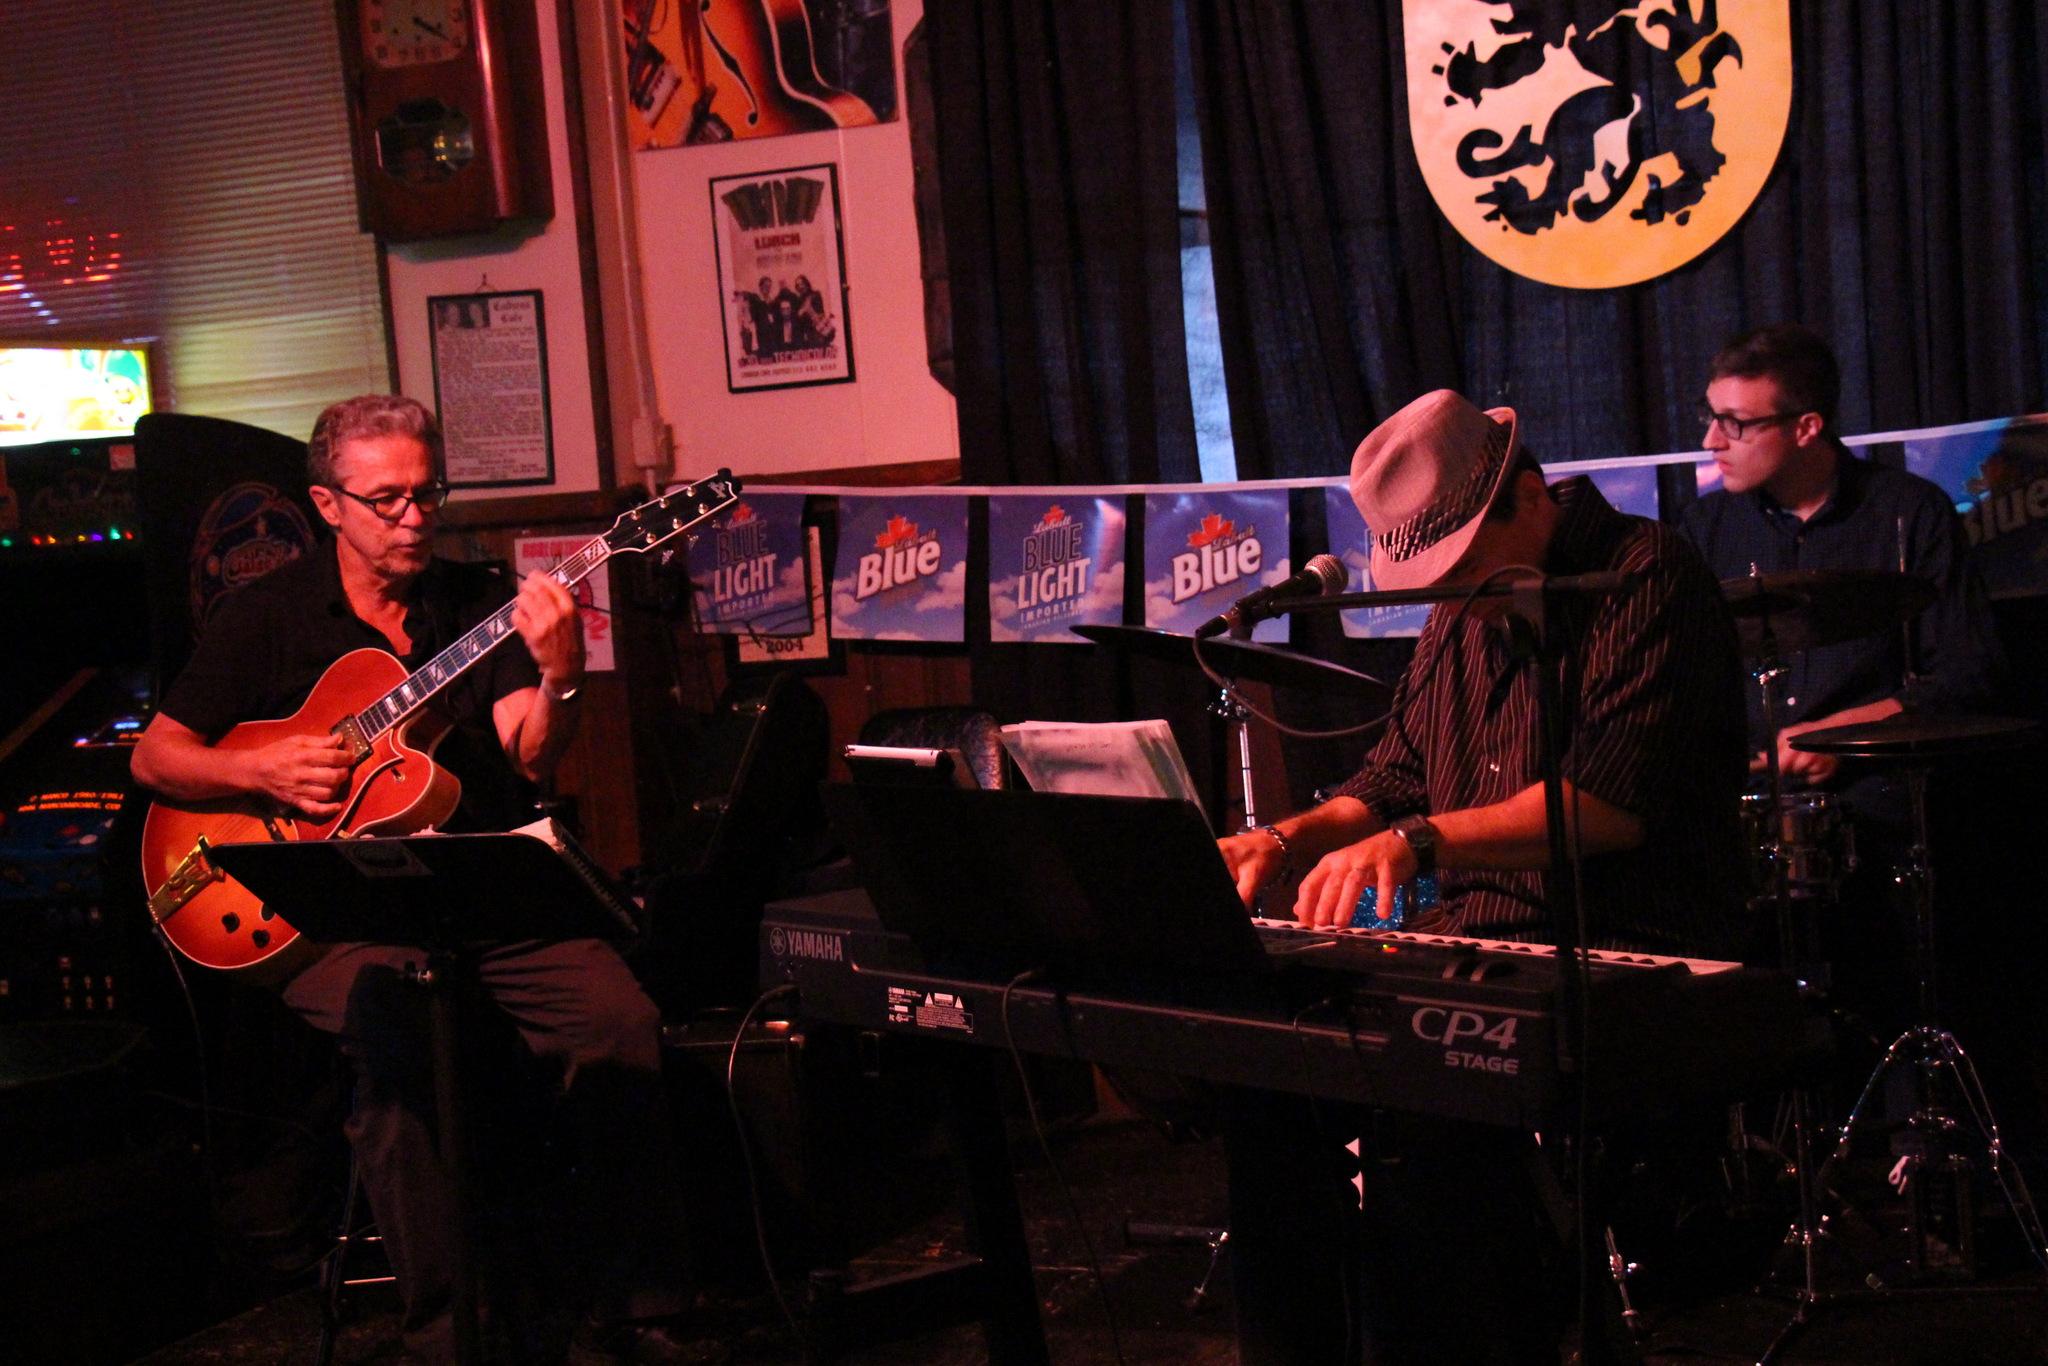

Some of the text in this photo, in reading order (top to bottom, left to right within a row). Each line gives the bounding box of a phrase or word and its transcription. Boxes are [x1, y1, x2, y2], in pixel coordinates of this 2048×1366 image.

[717, 519, 770, 567] BLUE
[1033, 514, 1072, 535] Labatt
[1211, 524, 1255, 551] Labatt
[856, 540, 942, 602] Blue
[1023, 523, 1083, 574] BLUE
[1172, 537, 1263, 604] Blue
[714, 553, 777, 603] LIGHT
[1018, 558, 1091, 610] LIGHT
[765, 638, 804, 654] 2004
[786, 930, 843, 962] YAMAHA
[1411, 1006, 1518, 1051] CP4
[1444, 1051, 1520, 1075] STAGE
